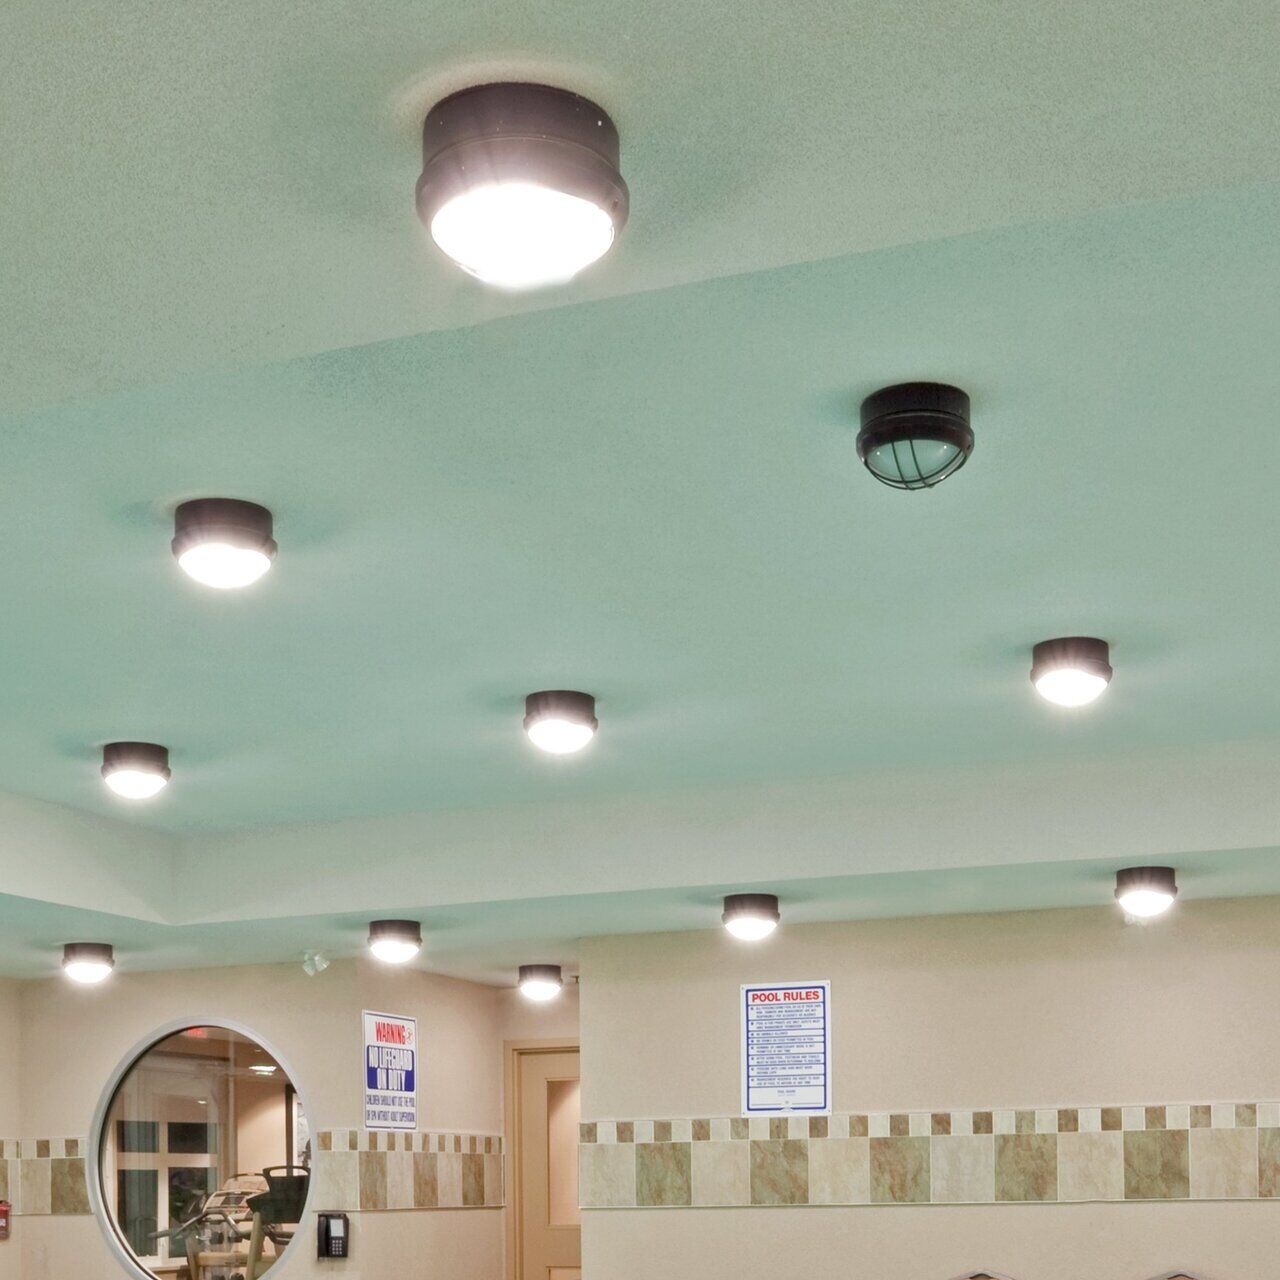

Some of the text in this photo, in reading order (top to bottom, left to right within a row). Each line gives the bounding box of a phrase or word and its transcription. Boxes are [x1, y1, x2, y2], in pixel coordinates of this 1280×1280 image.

[751, 990, 820, 1003] POOL RULES
[375, 1021, 406, 1045] WARNING
